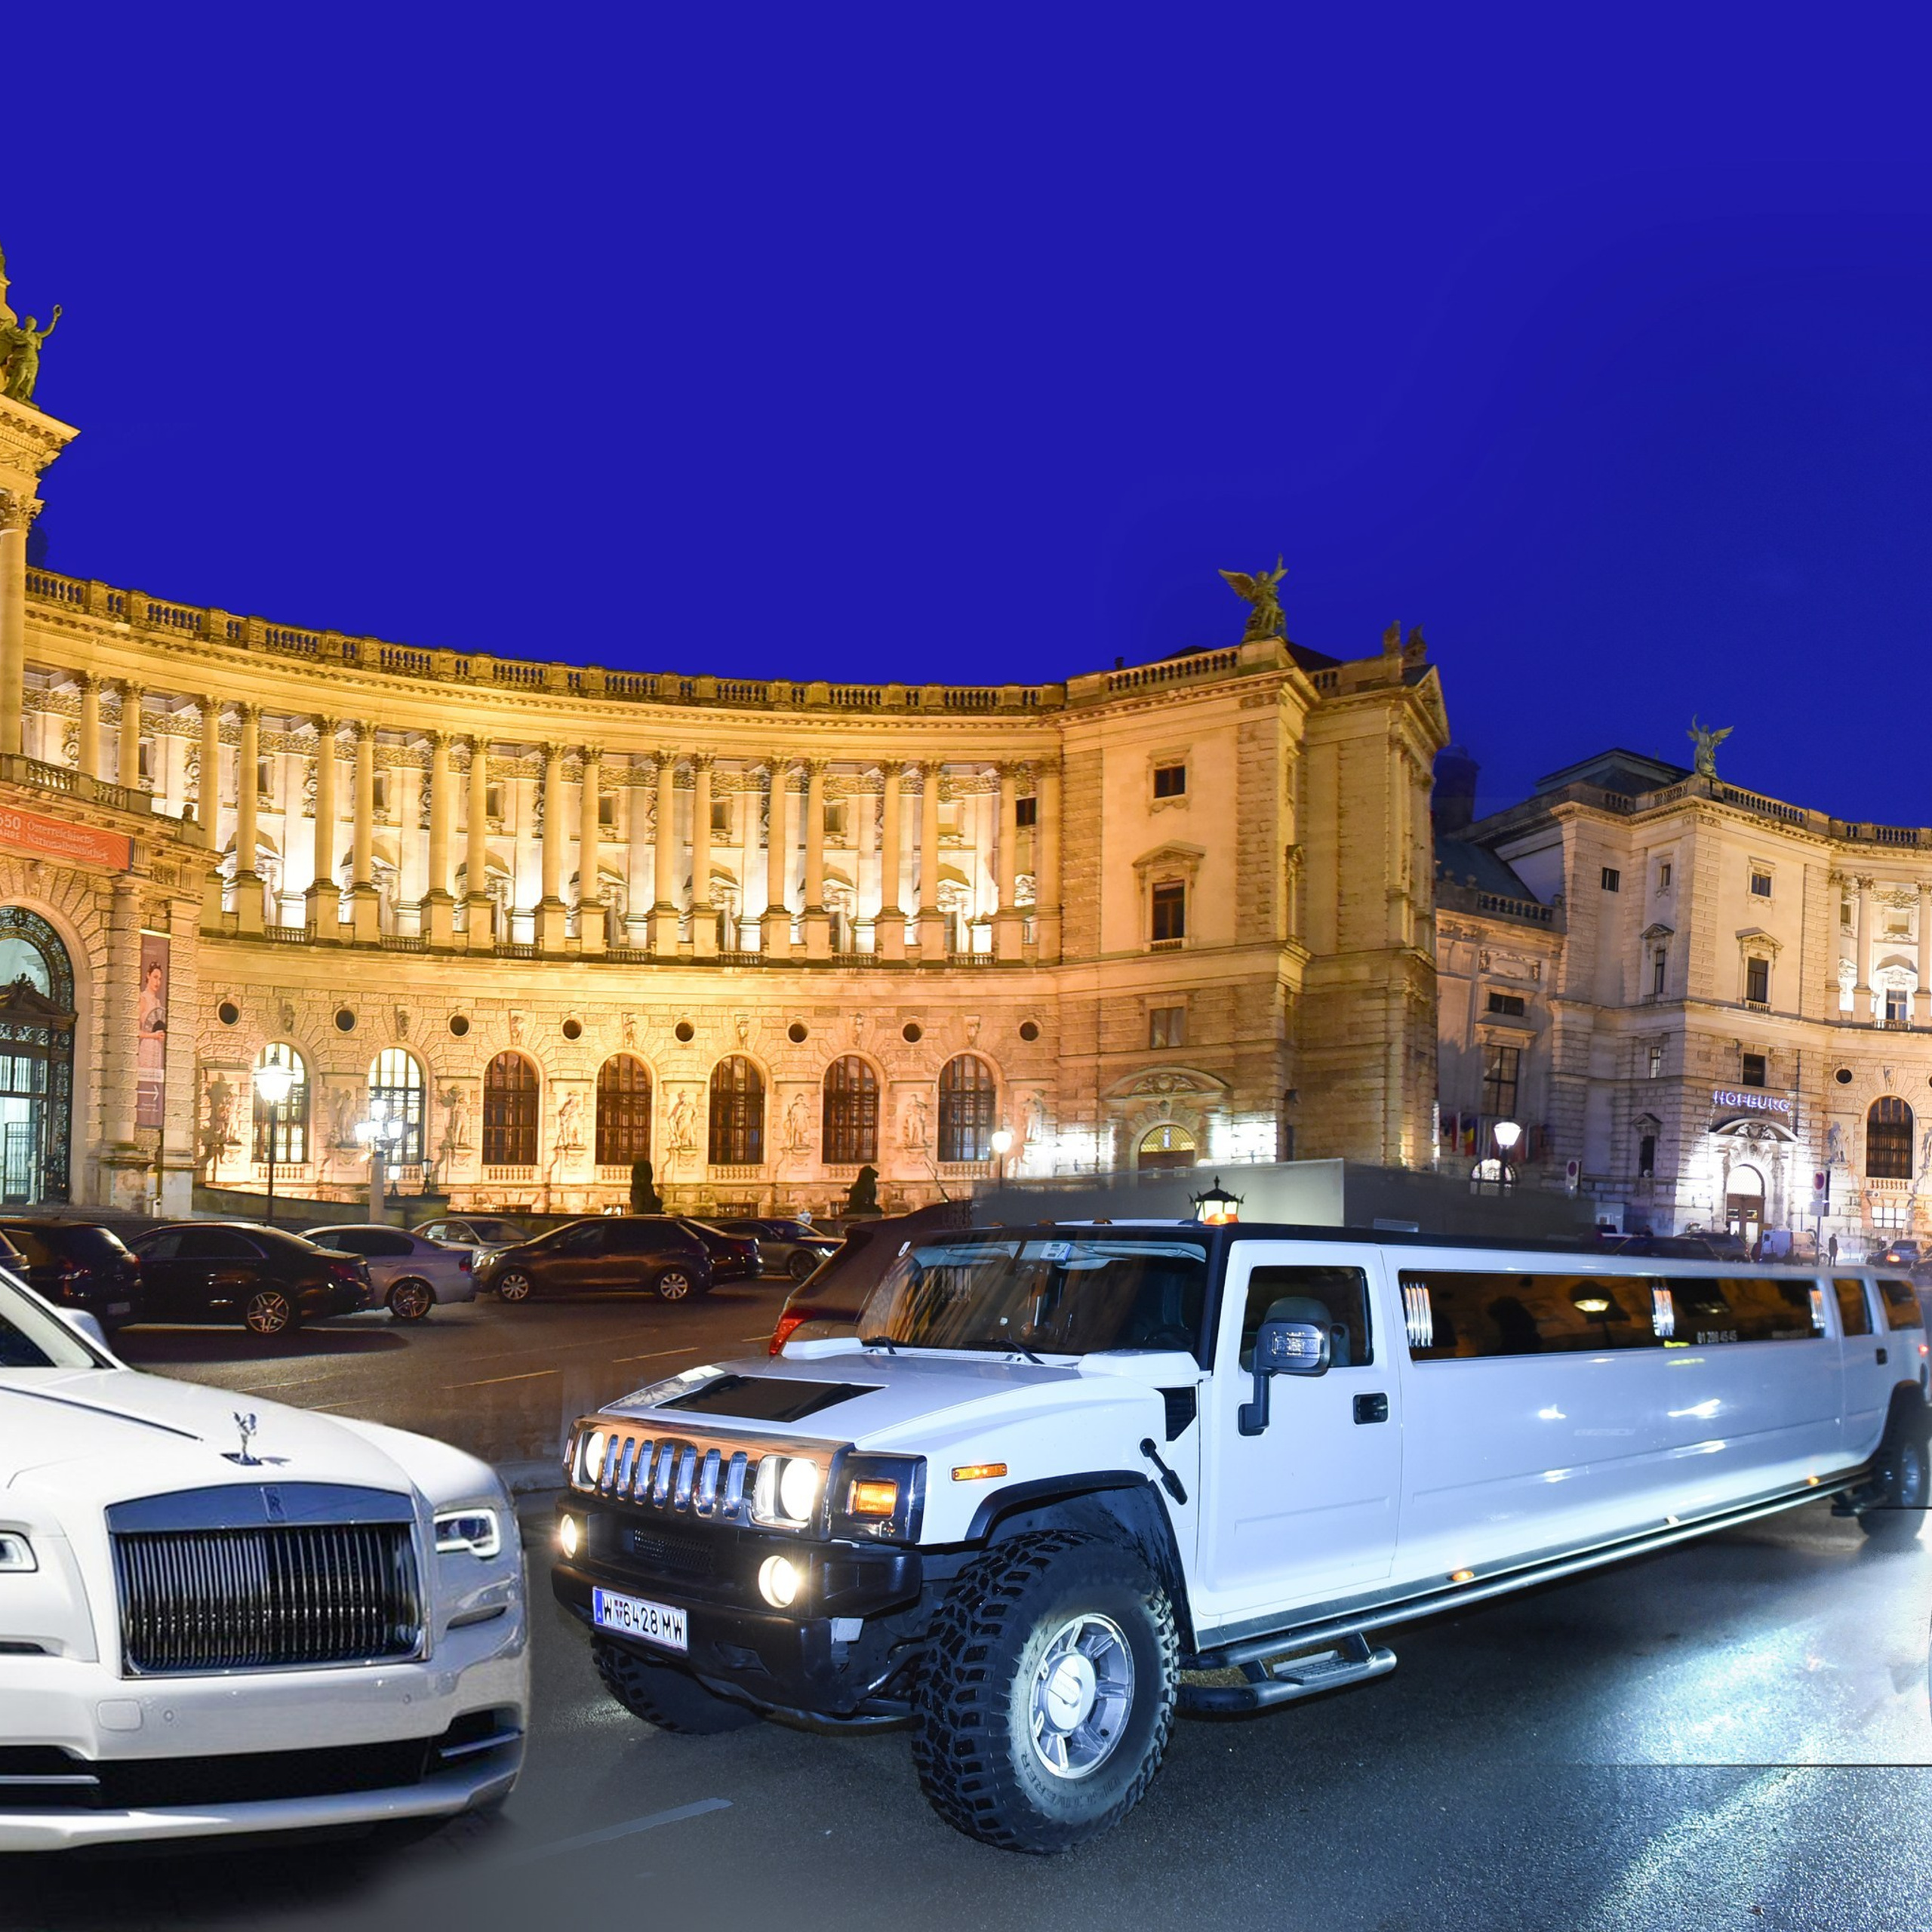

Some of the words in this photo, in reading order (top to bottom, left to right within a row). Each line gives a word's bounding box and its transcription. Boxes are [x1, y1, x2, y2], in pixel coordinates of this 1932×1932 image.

[1712, 1090, 1791, 1112] HOFBURG
[603, 1595, 614, 1622] W
[623, 1601, 660, 1635] 6428
[662, 1611, 684, 1643] MW
